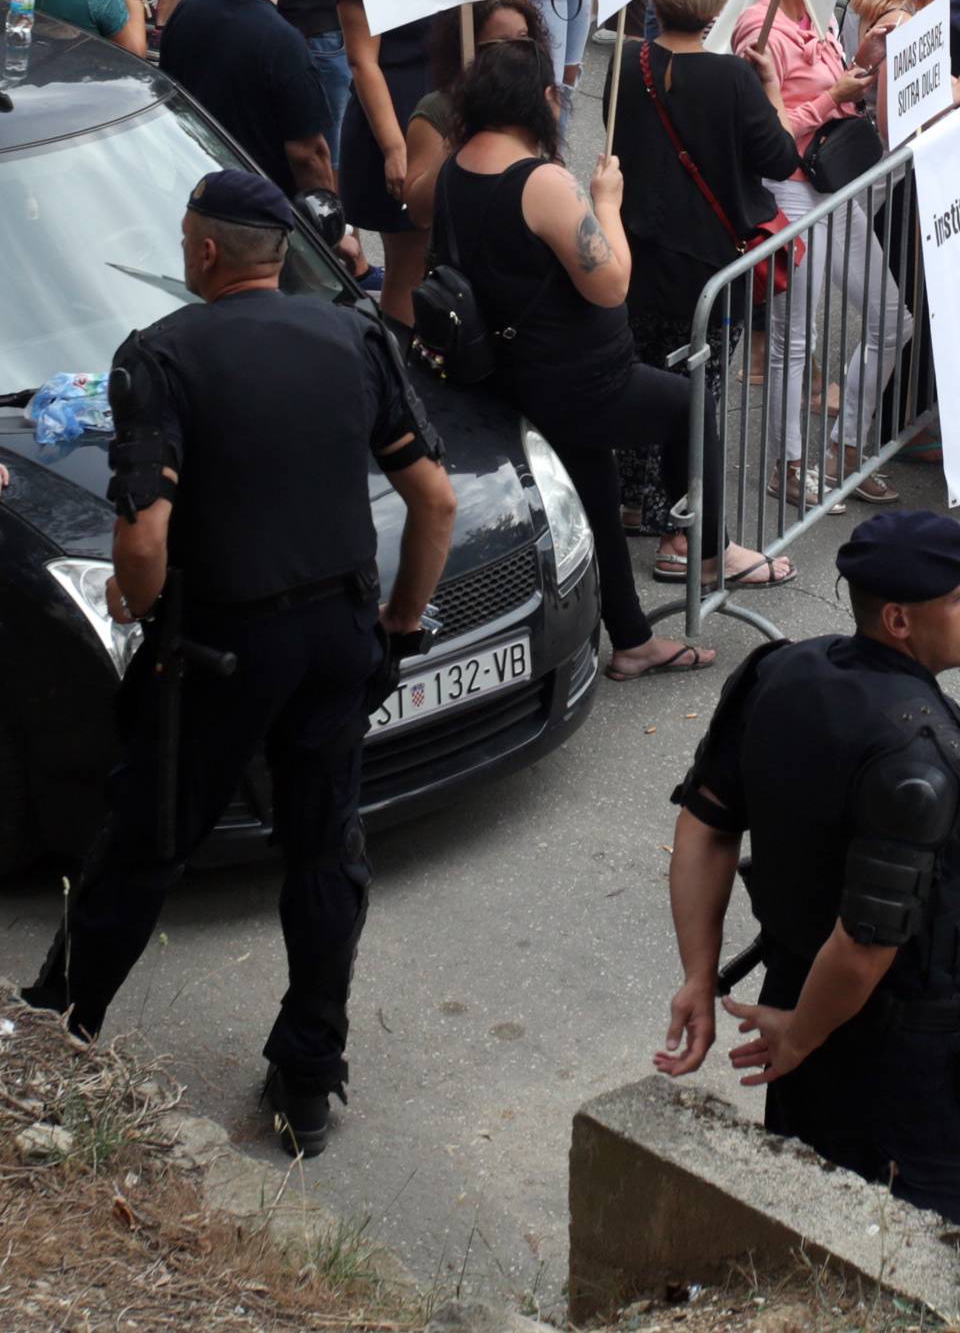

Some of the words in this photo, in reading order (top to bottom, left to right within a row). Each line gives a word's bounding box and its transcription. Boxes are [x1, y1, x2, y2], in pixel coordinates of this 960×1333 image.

[893, 42, 917, 81] DANAS
[919, 21, 944, 63] CESARE,
[898, 77, 920, 117] SUTRA
[922, 62, 941, 99] DUJE!
